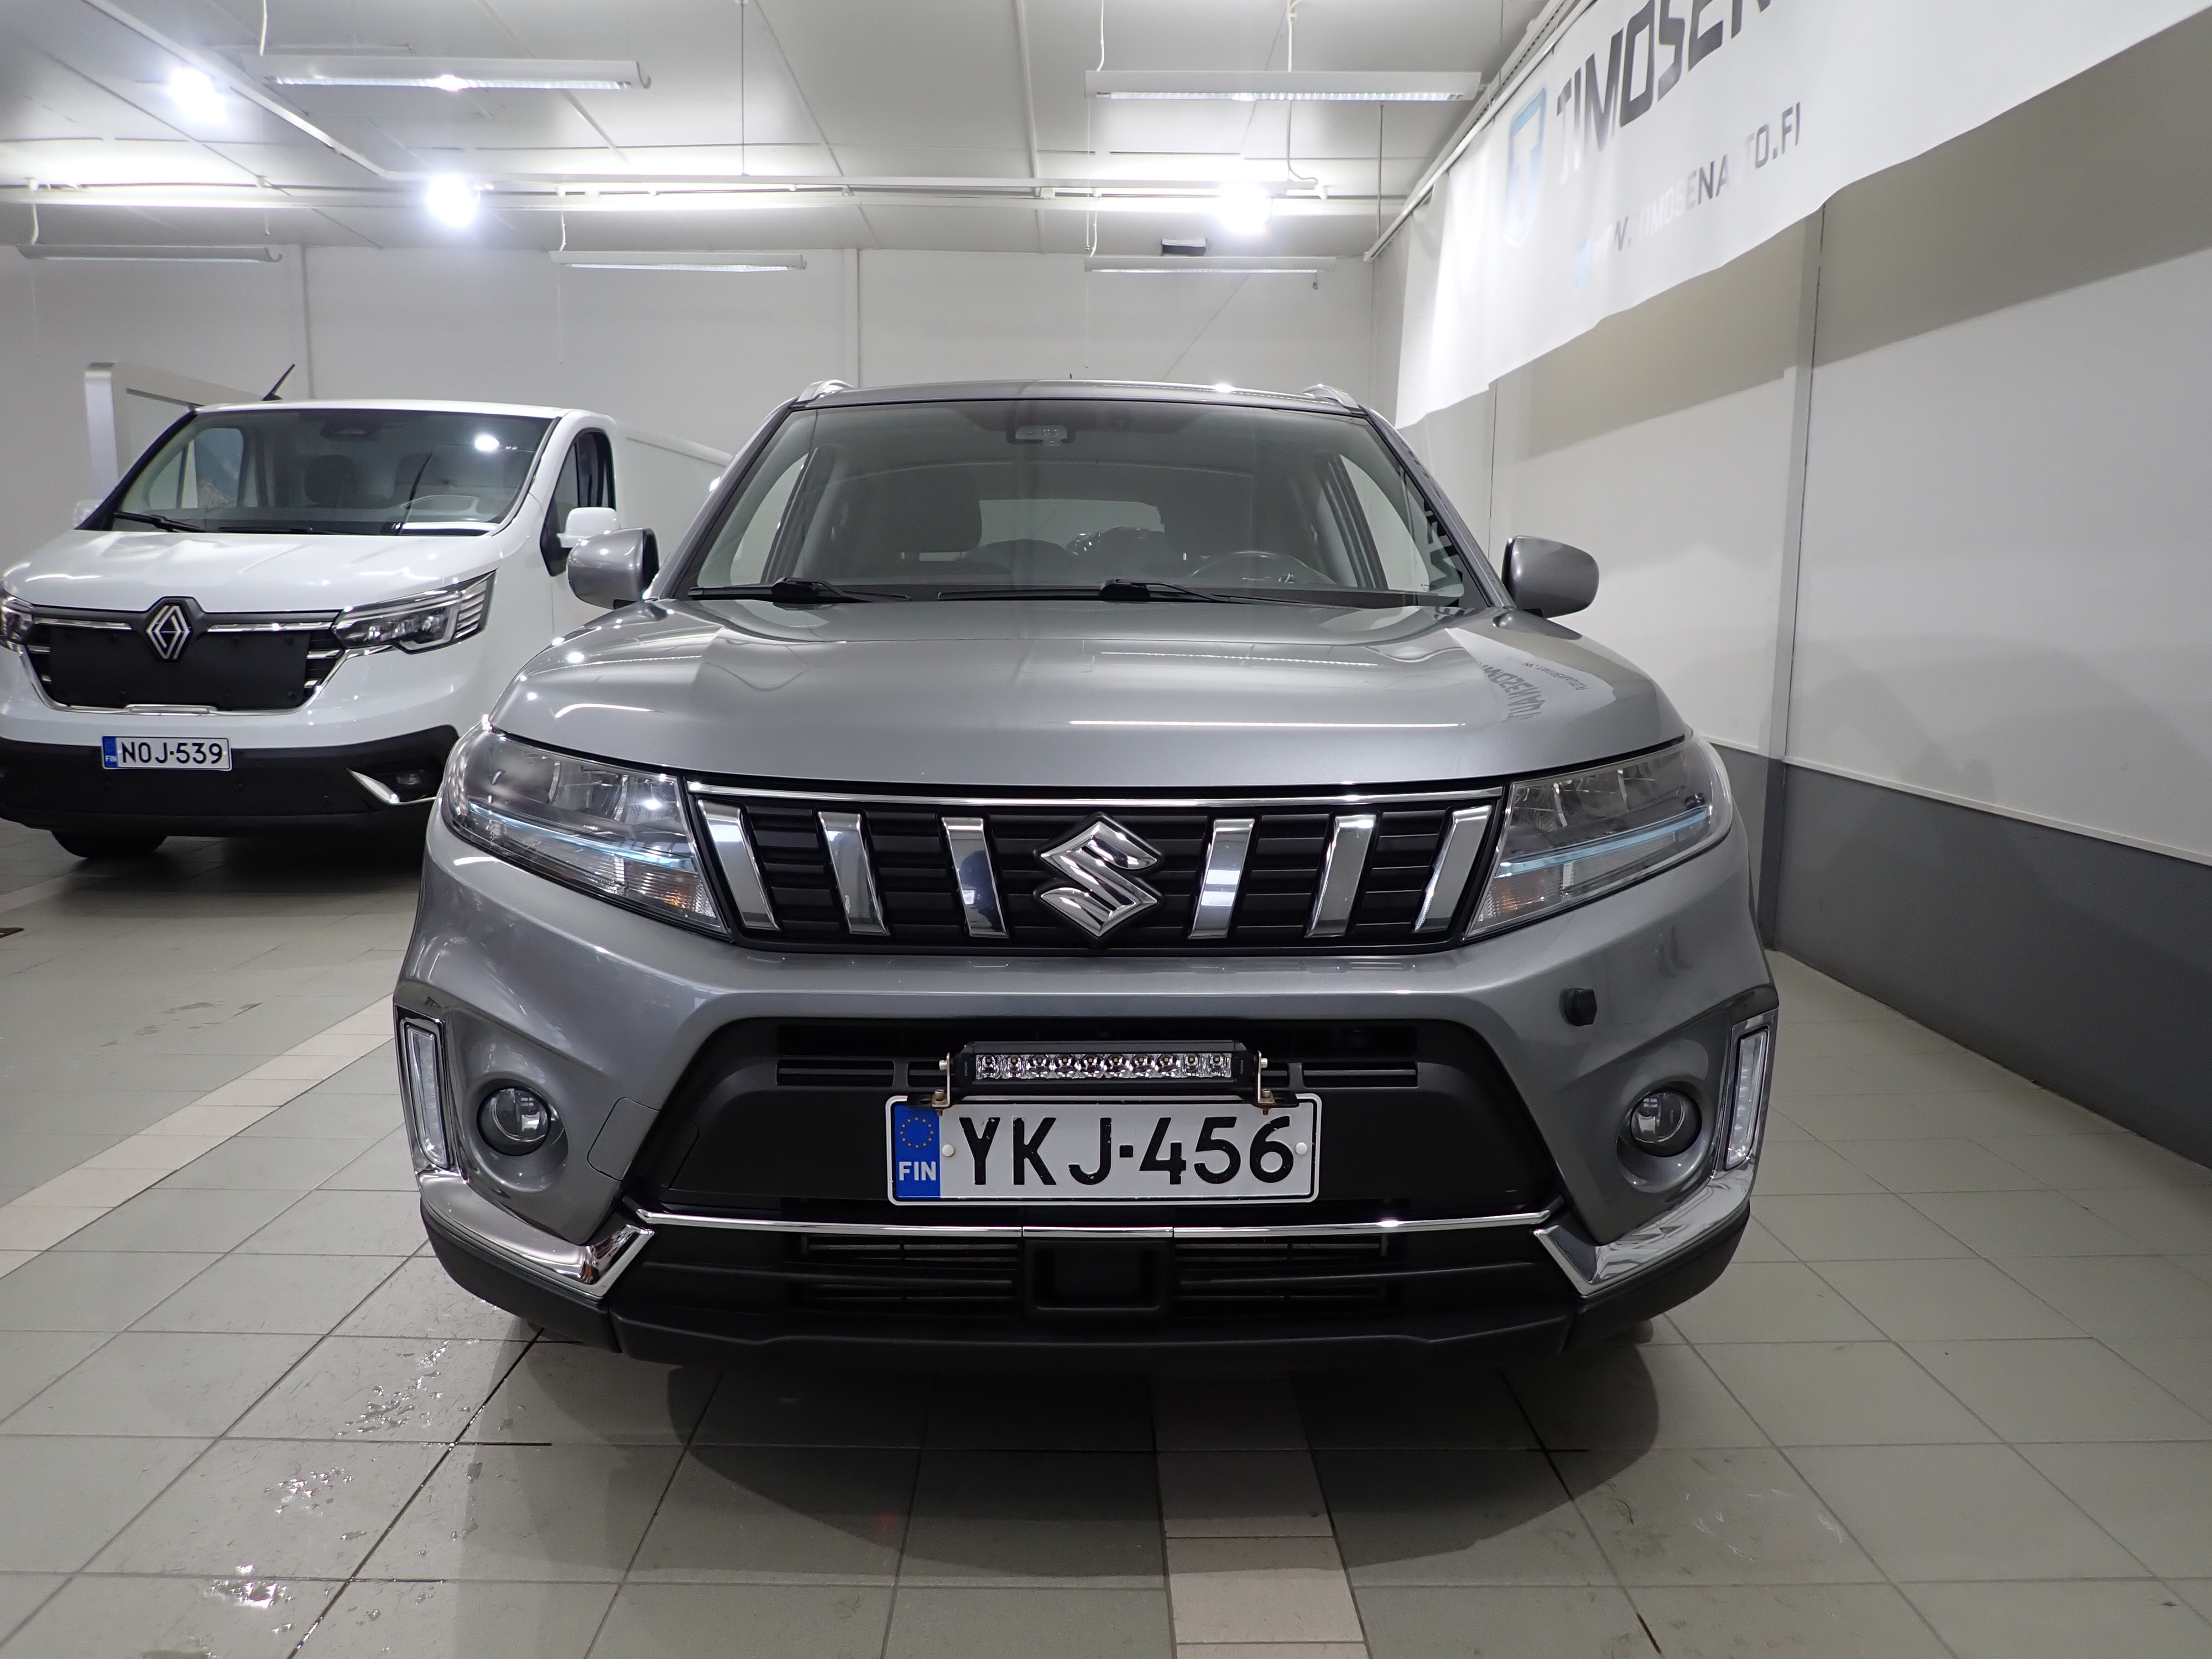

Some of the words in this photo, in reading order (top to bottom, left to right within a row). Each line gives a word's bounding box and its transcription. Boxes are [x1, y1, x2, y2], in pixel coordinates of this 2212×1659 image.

[122, 742, 222, 764] NOJ-539
[959, 1116, 1295, 1185] YKJ-456
[899, 1161, 936, 1181] FIN
